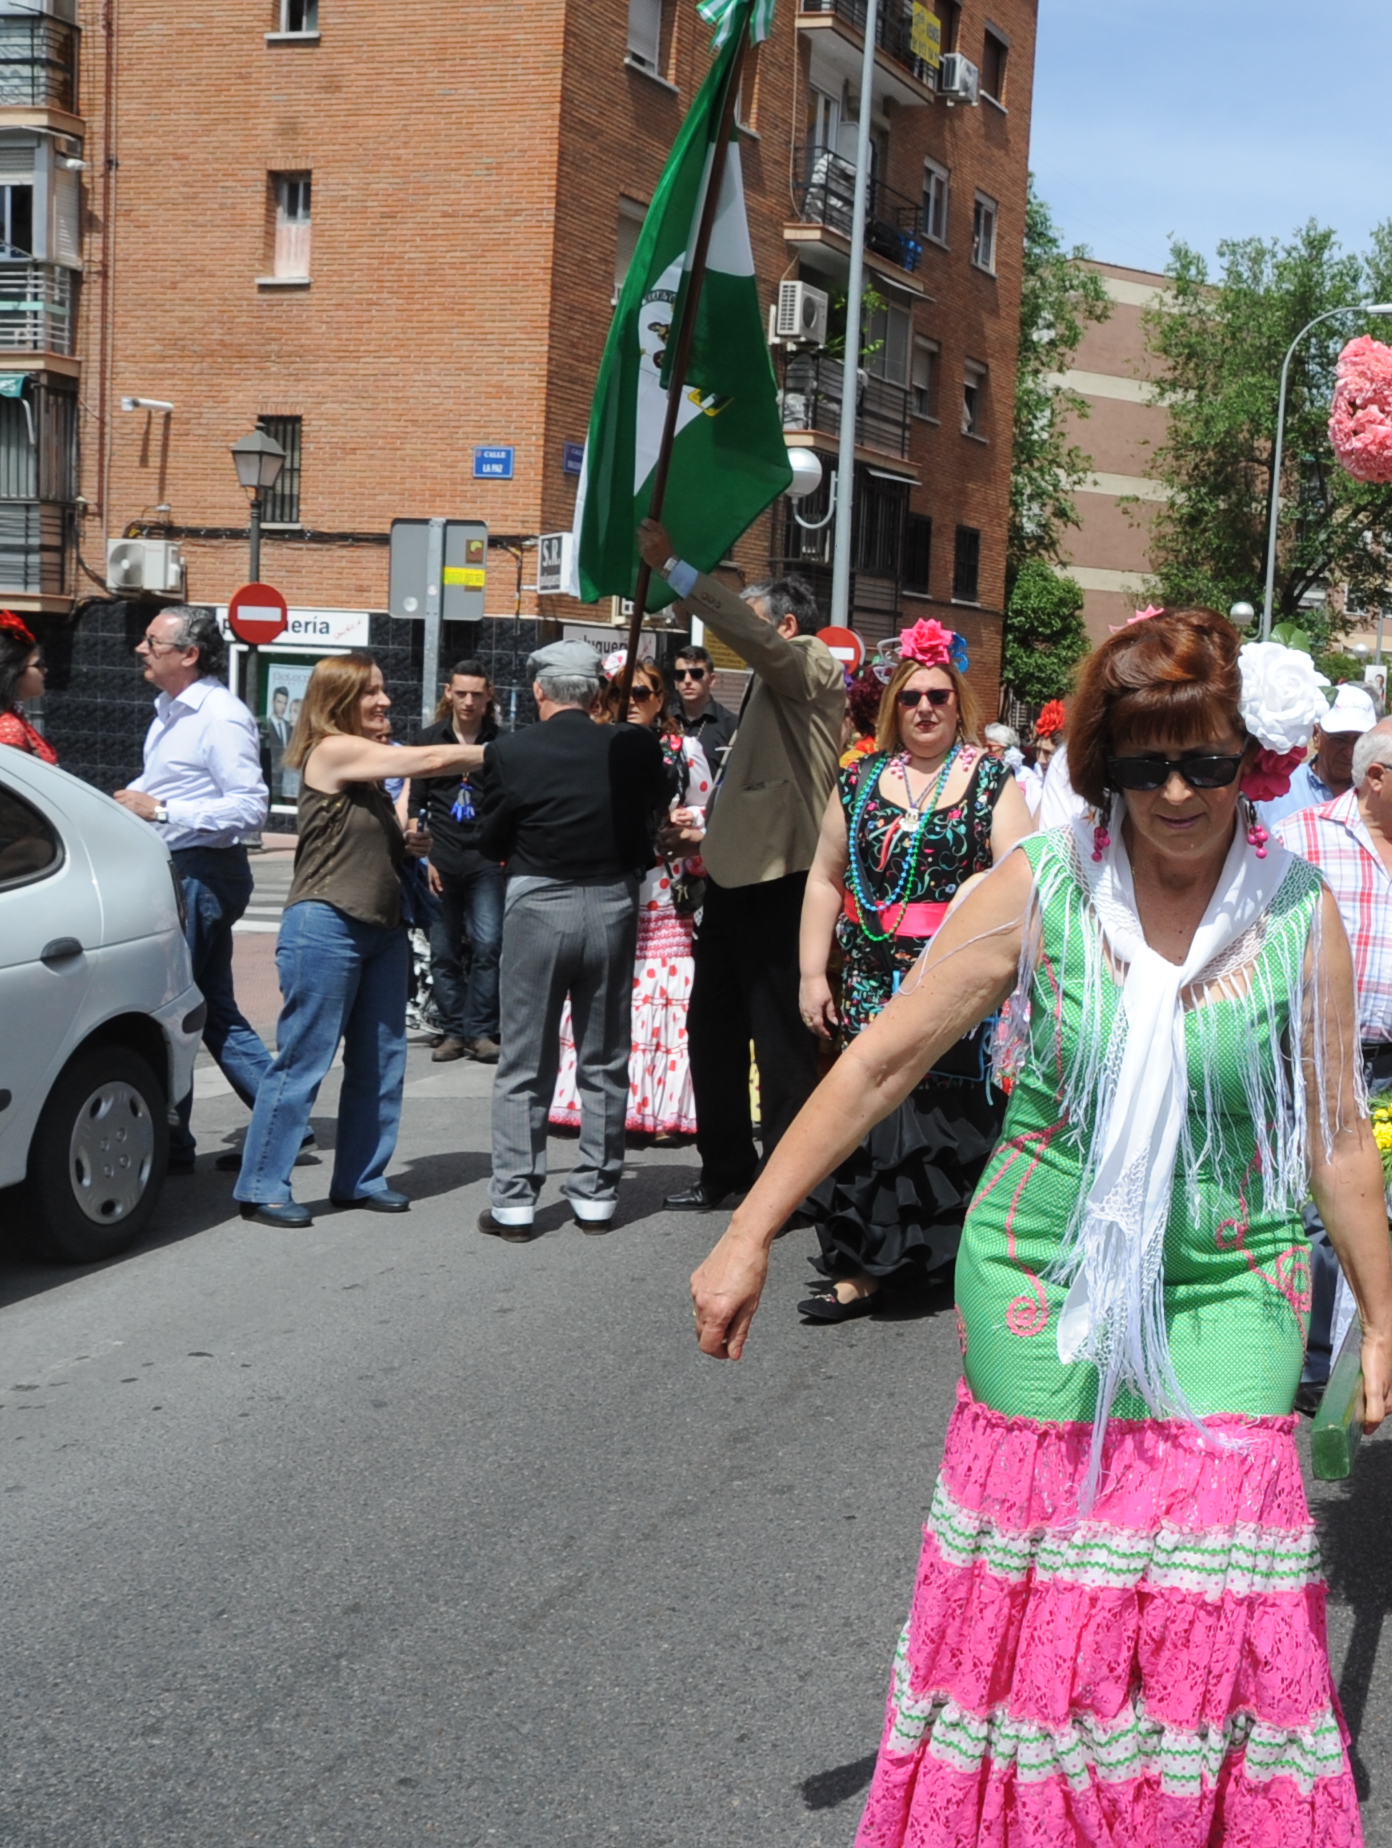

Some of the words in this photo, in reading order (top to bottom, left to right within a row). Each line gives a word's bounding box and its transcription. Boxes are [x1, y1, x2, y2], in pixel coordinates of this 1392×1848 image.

[482, 464, 491, 472] LA
[492, 464, 503, 473] PAZ
[542, 539, 561, 567] S.R.
